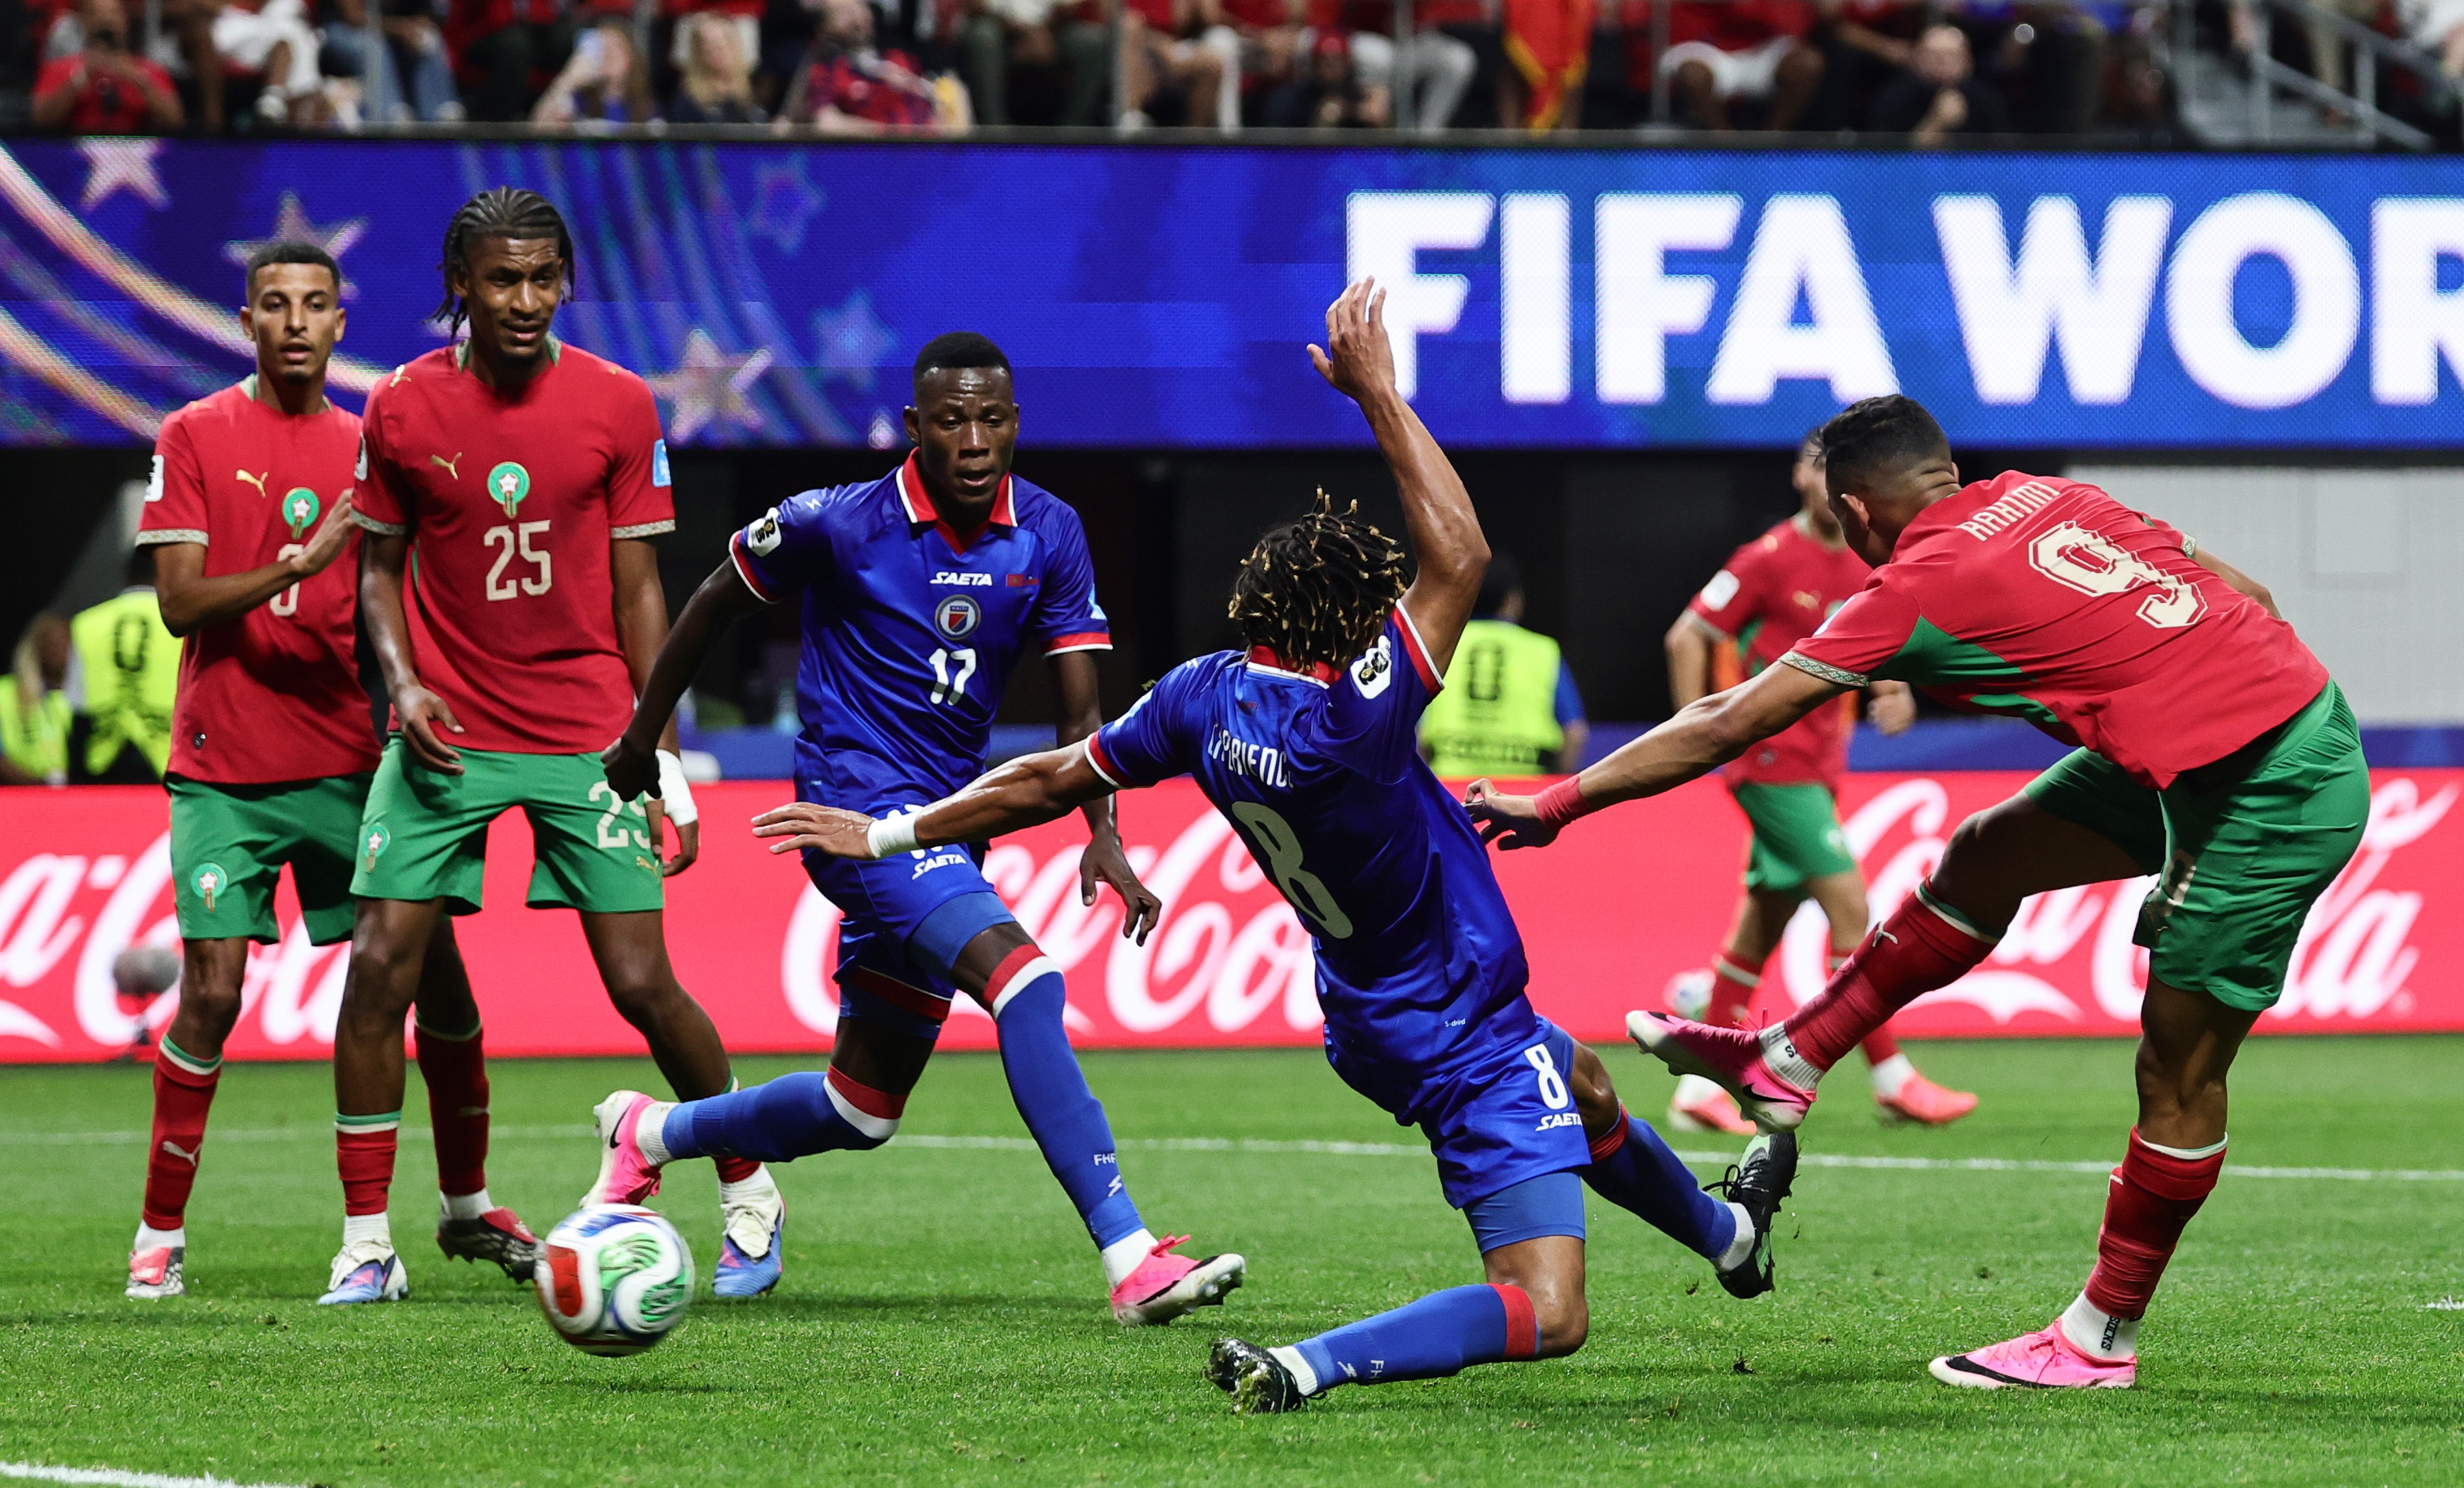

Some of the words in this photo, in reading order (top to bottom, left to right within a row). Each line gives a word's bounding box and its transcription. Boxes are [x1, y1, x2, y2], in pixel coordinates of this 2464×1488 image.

[1346, 189, 1902, 405] FIFA
[1955, 481, 2061, 542] RAHIMI
[484, 519, 552, 602] 25
[929, 571, 993, 586] SAETA
[2027, 520, 2209, 628] 9
[929, 648, 976, 706] 17
[911, 854, 967, 880] SAETA
[1232, 801, 1353, 939] 8
[1524, 1043, 1569, 1110] 8
